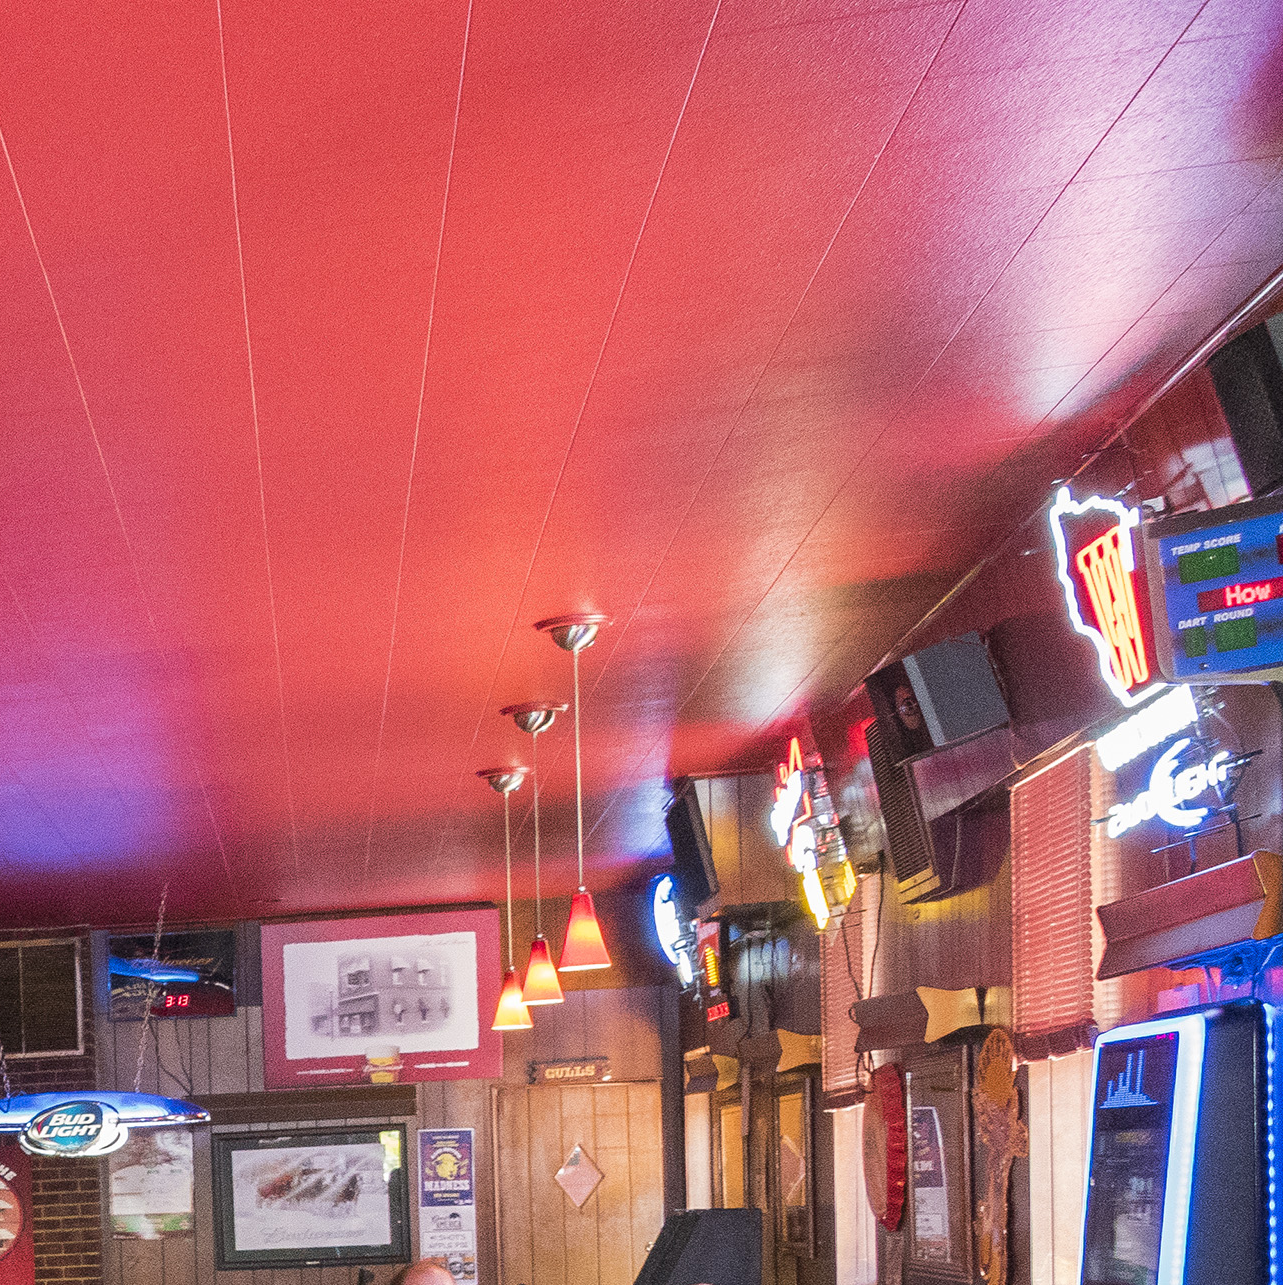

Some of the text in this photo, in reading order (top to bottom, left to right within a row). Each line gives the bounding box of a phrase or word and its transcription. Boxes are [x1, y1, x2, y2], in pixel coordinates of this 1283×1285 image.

[1171, 533, 1241, 557] TEMP SCORE
[1223, 583, 1272, 606] How
[1178, 607, 1254, 630] DART ROUND
[165, 994, 190, 1008] 3:13
[544, 1065, 597, 1080] GULLS
[49, 1112, 96, 1127] BUD
[40, 1125, 102, 1139] LIGHT
[423, 1179, 471, 1192] MADNESS
